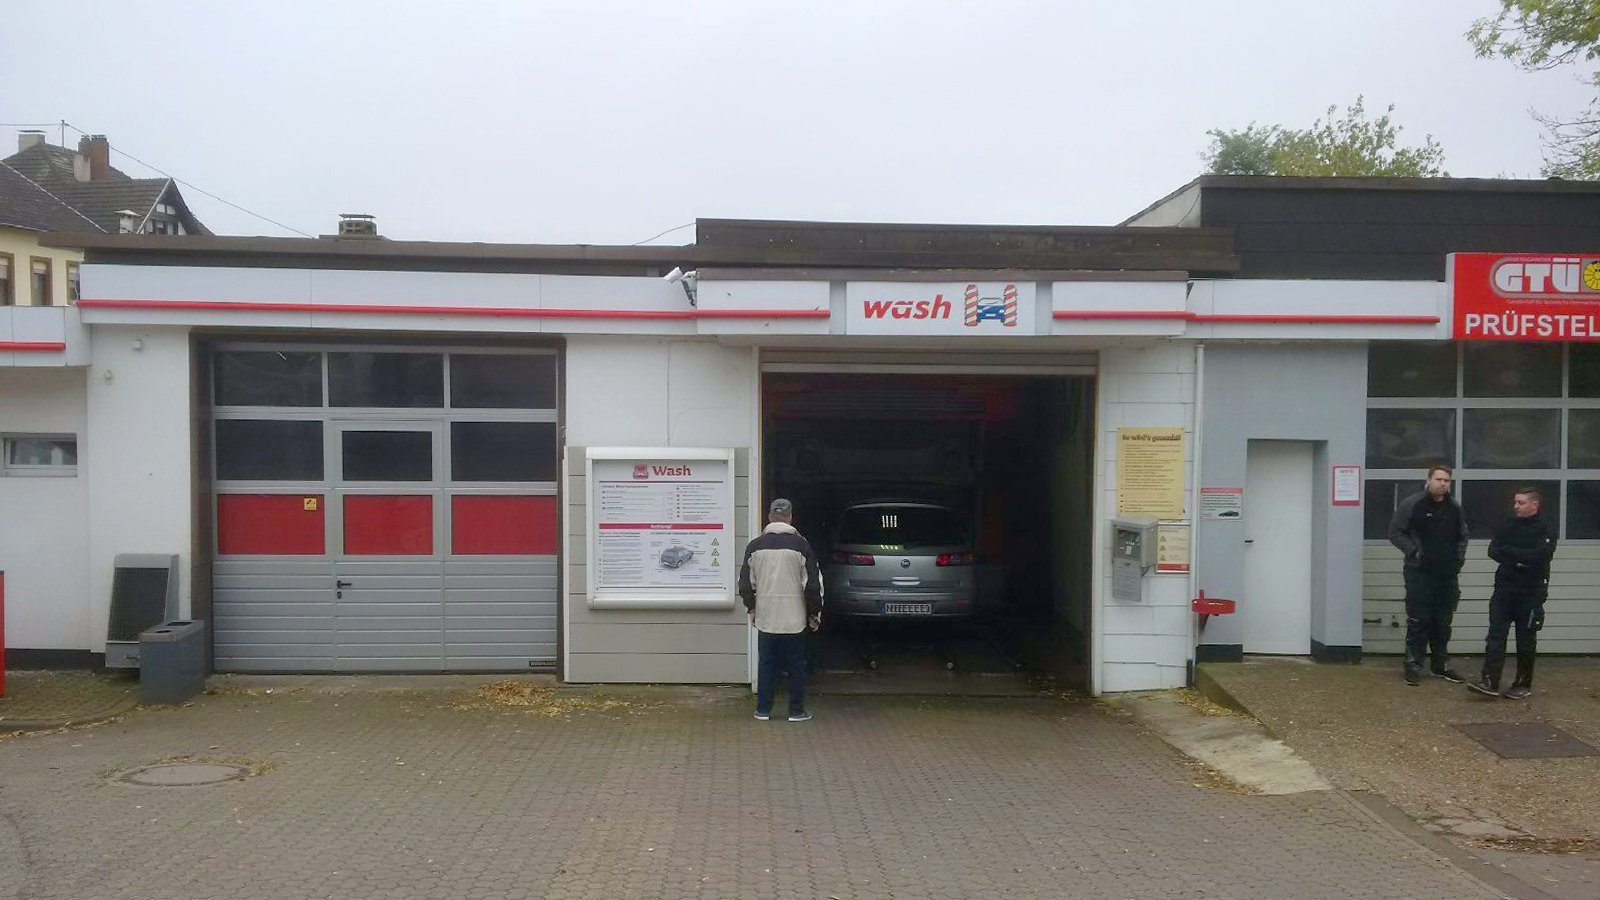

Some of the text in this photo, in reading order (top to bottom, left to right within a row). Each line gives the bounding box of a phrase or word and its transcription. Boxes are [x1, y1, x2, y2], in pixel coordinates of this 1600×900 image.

[1495, 258, 1581, 292] GTÜ
[863, 294, 952, 320] wash
[652, 465, 691, 477] Wash
